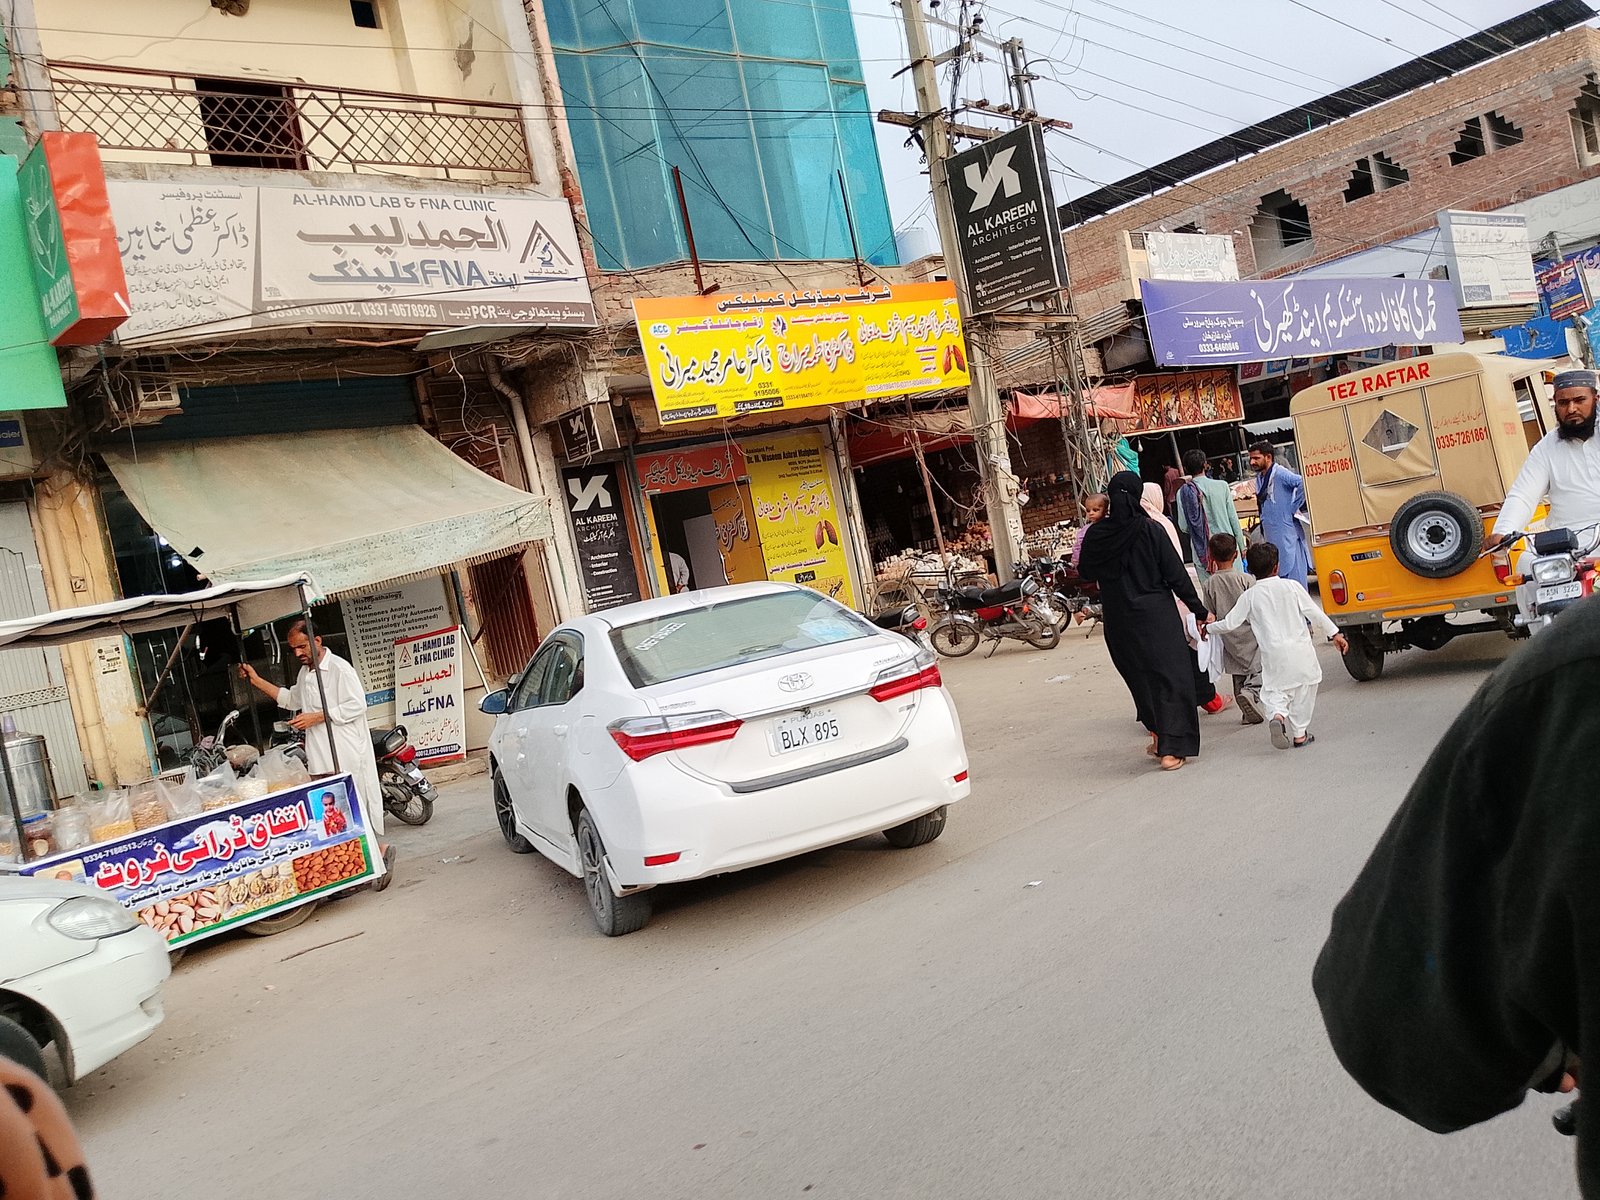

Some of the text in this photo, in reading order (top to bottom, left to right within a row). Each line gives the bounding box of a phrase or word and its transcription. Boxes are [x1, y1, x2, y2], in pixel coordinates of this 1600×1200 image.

[160, 188, 203, 202] پروفیسر
[293, 193, 497, 212] AL-HAMD LAB & FNA CLINIC
[967, 200, 1038, 238] AL KAREEM
[116, 221, 171, 260] شاہین
[211, 212, 249, 258] ڈاکٹر
[296, 214, 509, 256] الحمد لیب
[972, 217, 1037, 247] ARCHITECTS
[308, 258, 420, 294] کلینک
[421, 259, 488, 287] FNA
[362, 303, 438, 318] 0337-0678926
[718, 286, 891, 314] شریف میڈیکل کمپلیکس
[471, 305, 498, 319] PCR
[1408, 284, 1437, 341] محمدی
[653, 325, 669, 334] ACC
[828, 331, 855, 373] ڈاکٹر
[660, 336, 773, 390] ڈاکٹر عامر مجید میرانی
[1327, 362, 1431, 402] TEZ RAFTAR
[1436, 426, 1489, 450] 0335-7261861
[668, 457, 702, 485] میڈیکل
[701, 449, 734, 479] شریف
[1305, 456, 1353, 477] 0335-7261861
[575, 513, 617, 525] AL KAREEM
[576, 522, 619, 533] ARCHITECTS
[355, 604, 373, 612] FNAC
[356, 604, 416, 619] Hormones Analysis
[357, 605, 444, 627] Chemistry (Fully Automated)
[359, 613, 439, 634] Haematology (Automated)
[381, 627, 407, 636] Immuno
[407, 623, 429, 632] assays
[362, 639, 382, 648] Stone
[364, 646, 388, 655] Culture
[413, 634, 455, 654] AL-HAMD LAB
[366, 655, 382, 663] Fluid
[414, 647, 455, 666] & FNA CLINIC
[400, 663, 456, 690] الحمد لیب
[428, 694, 455, 712] FNA
[790, 711, 825, 723] PUNJAB
[781, 719, 839, 749] BLX 895
[94, 801, 306, 890] اتفاق ڈرائی فروٹ
